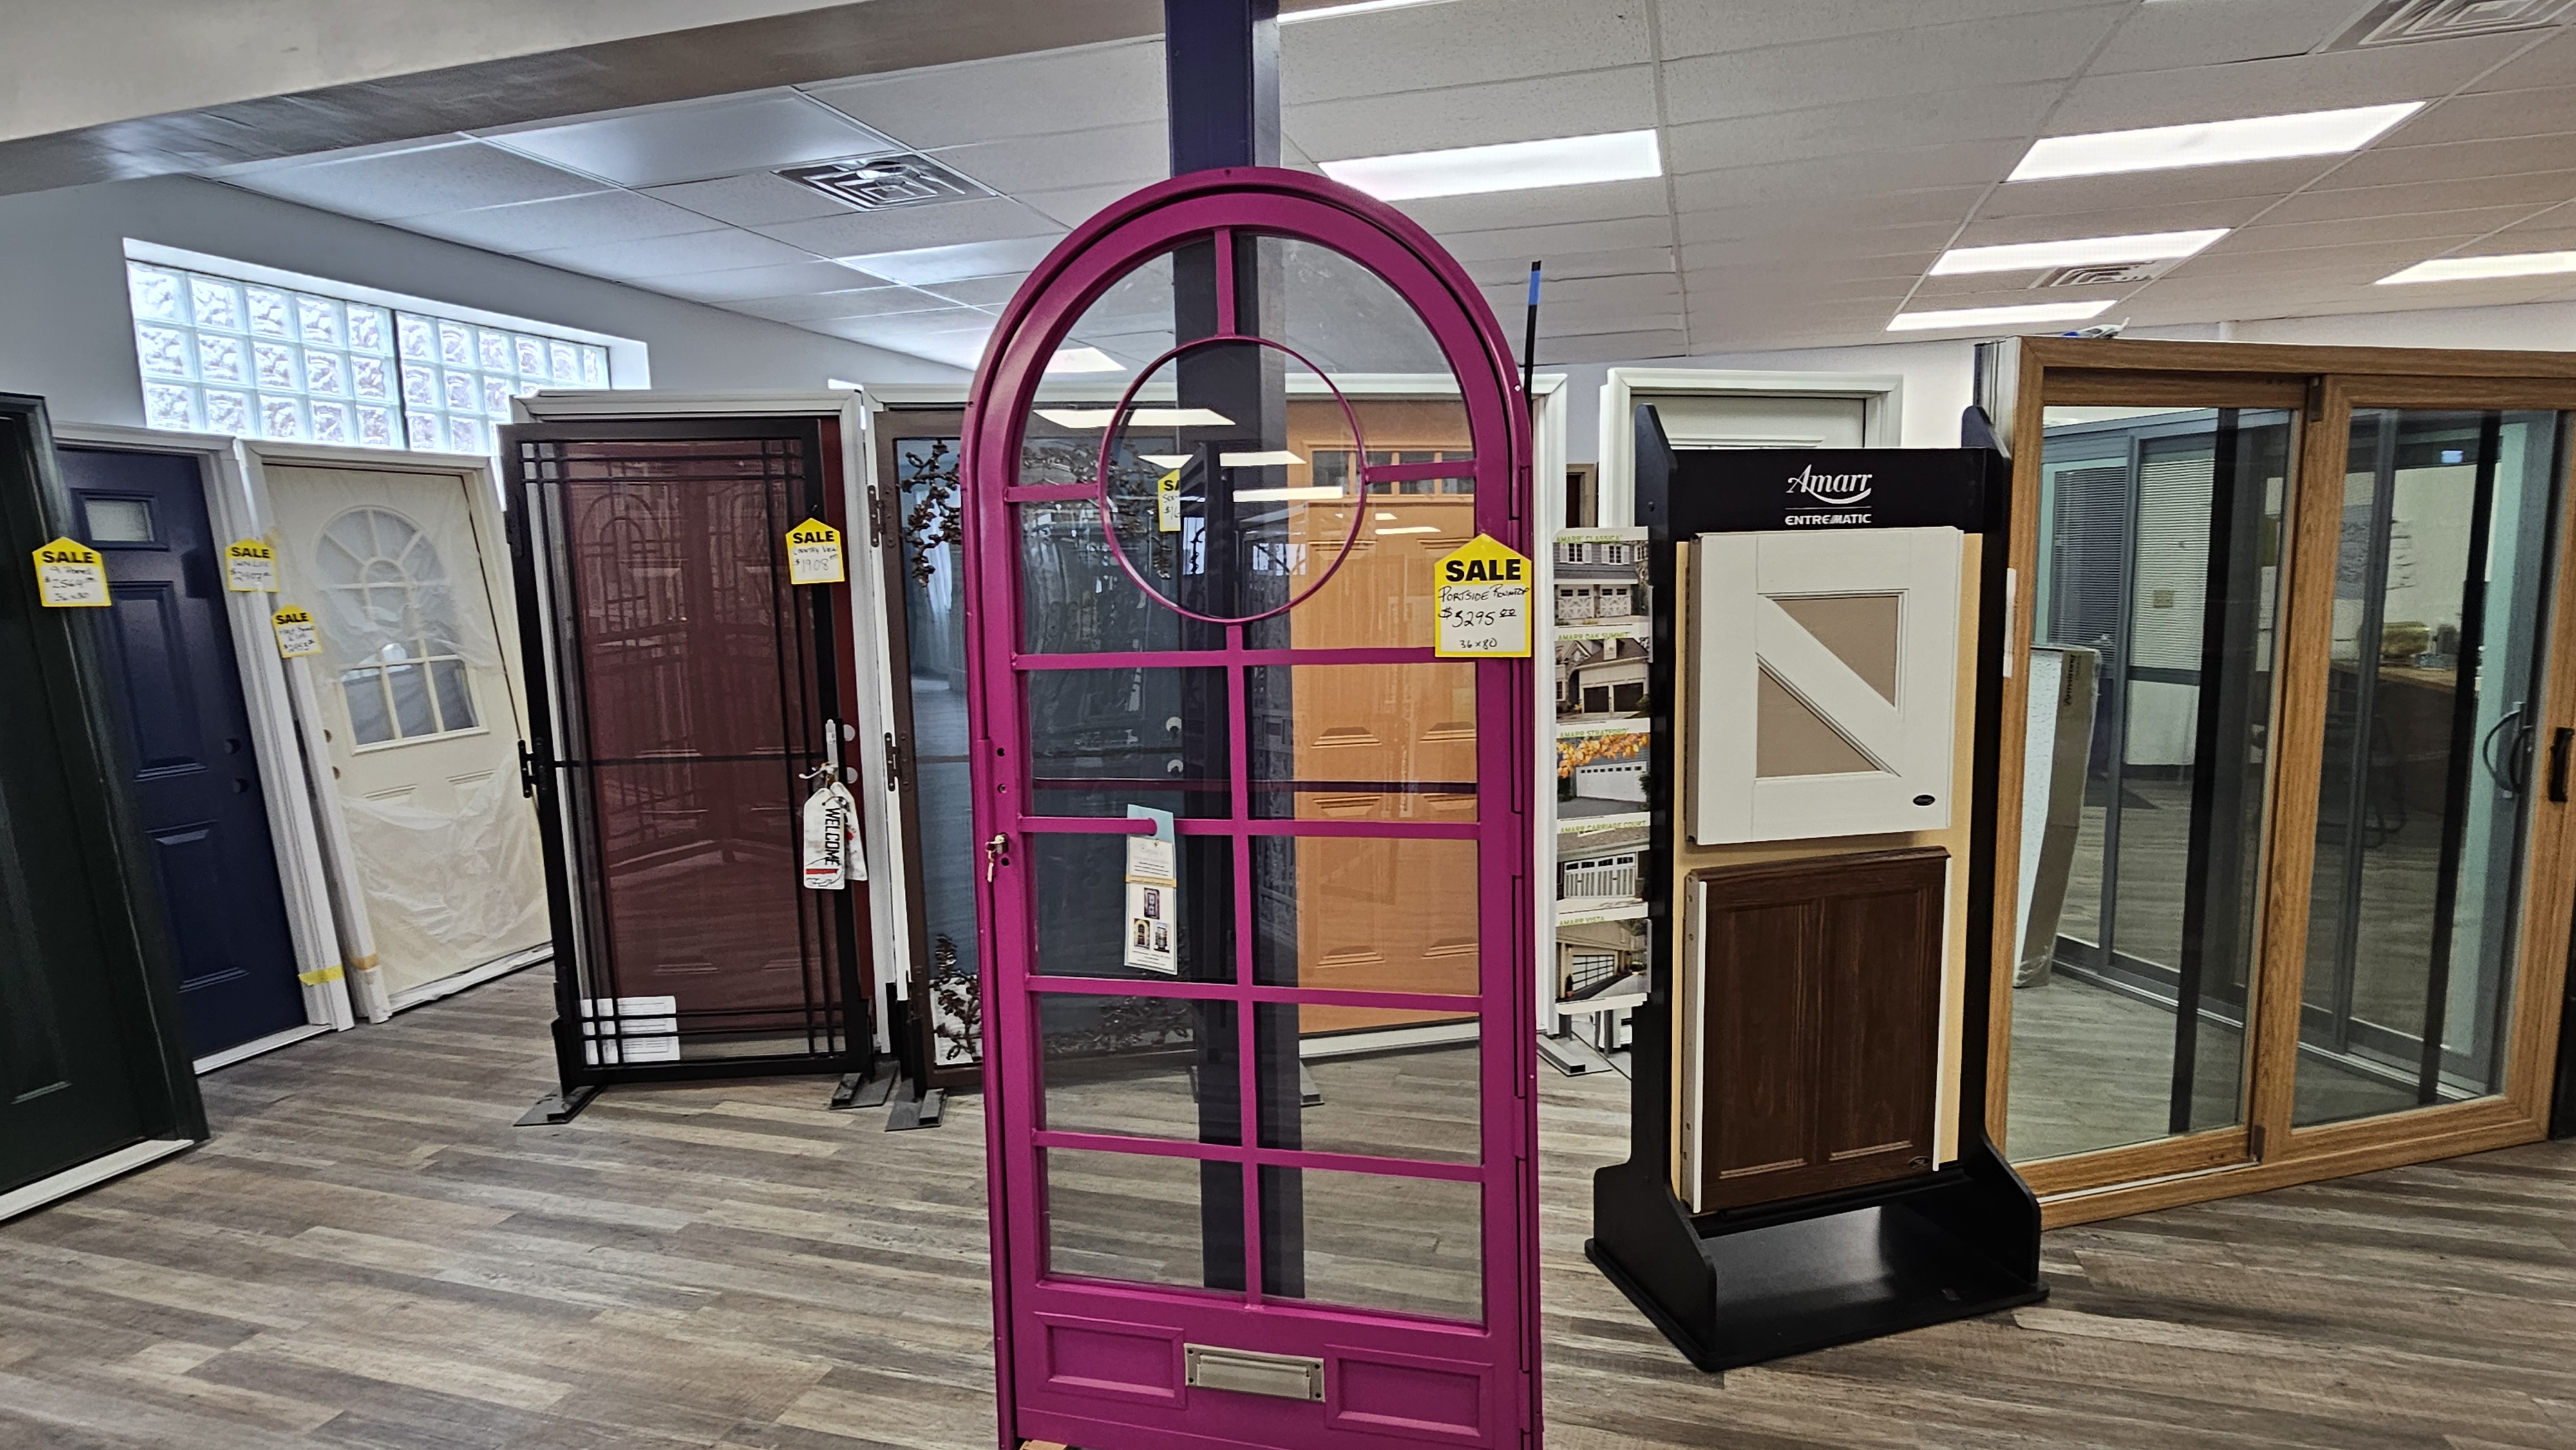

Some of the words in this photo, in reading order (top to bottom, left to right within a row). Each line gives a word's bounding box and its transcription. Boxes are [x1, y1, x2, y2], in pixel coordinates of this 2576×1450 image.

[1786, 464, 1873, 504] Amarr
[1785, 514, 1872, 525] ENTREMATIC
[793, 531, 835, 544] SALE
[42, 551, 95, 563] SALE
[231, 547, 272, 559] SALE
[1446, 559, 1521, 581] SALE
[276, 612, 309, 625] SALE
[825, 807, 841, 866] WELCOME
